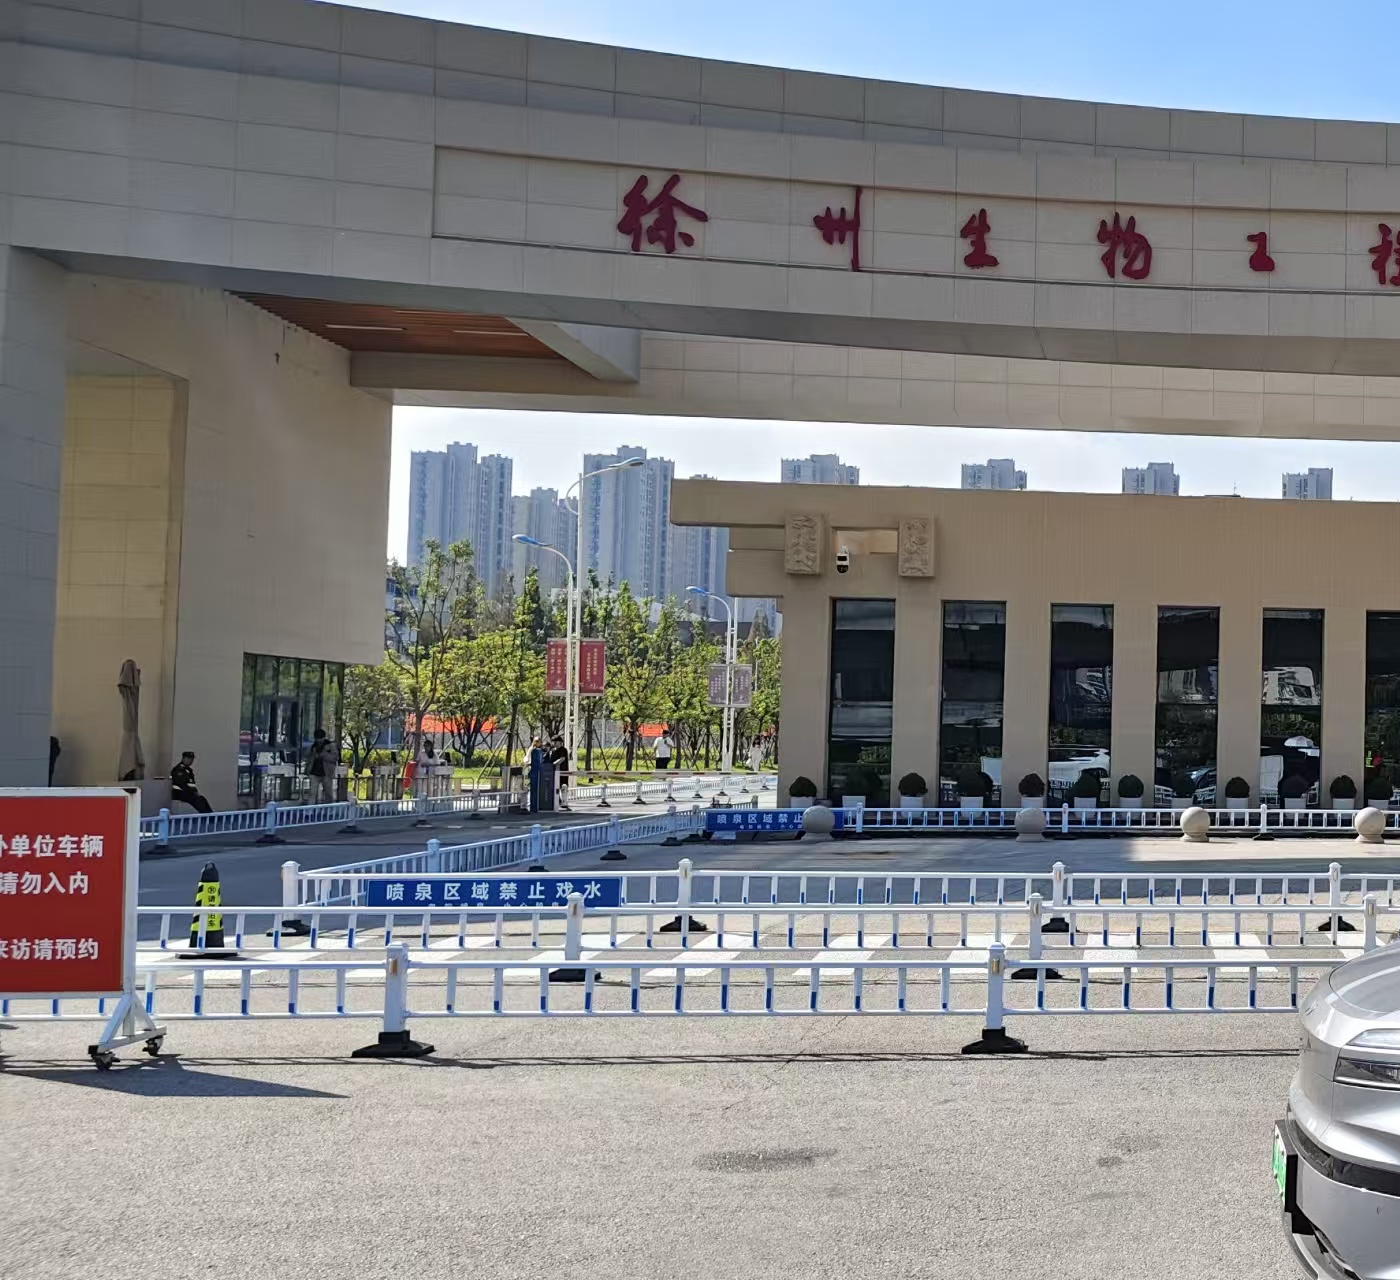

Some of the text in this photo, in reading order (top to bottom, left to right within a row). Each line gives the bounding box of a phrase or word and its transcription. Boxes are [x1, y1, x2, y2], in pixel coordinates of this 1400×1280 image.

[716, 813, 803, 824] 喷泉区域禁止
[0, 871, 89, 895] 请勿入内
[386, 881, 601, 901] 喷泉区域禁止戏水
[208, 895, 216, 927] 请泊车
